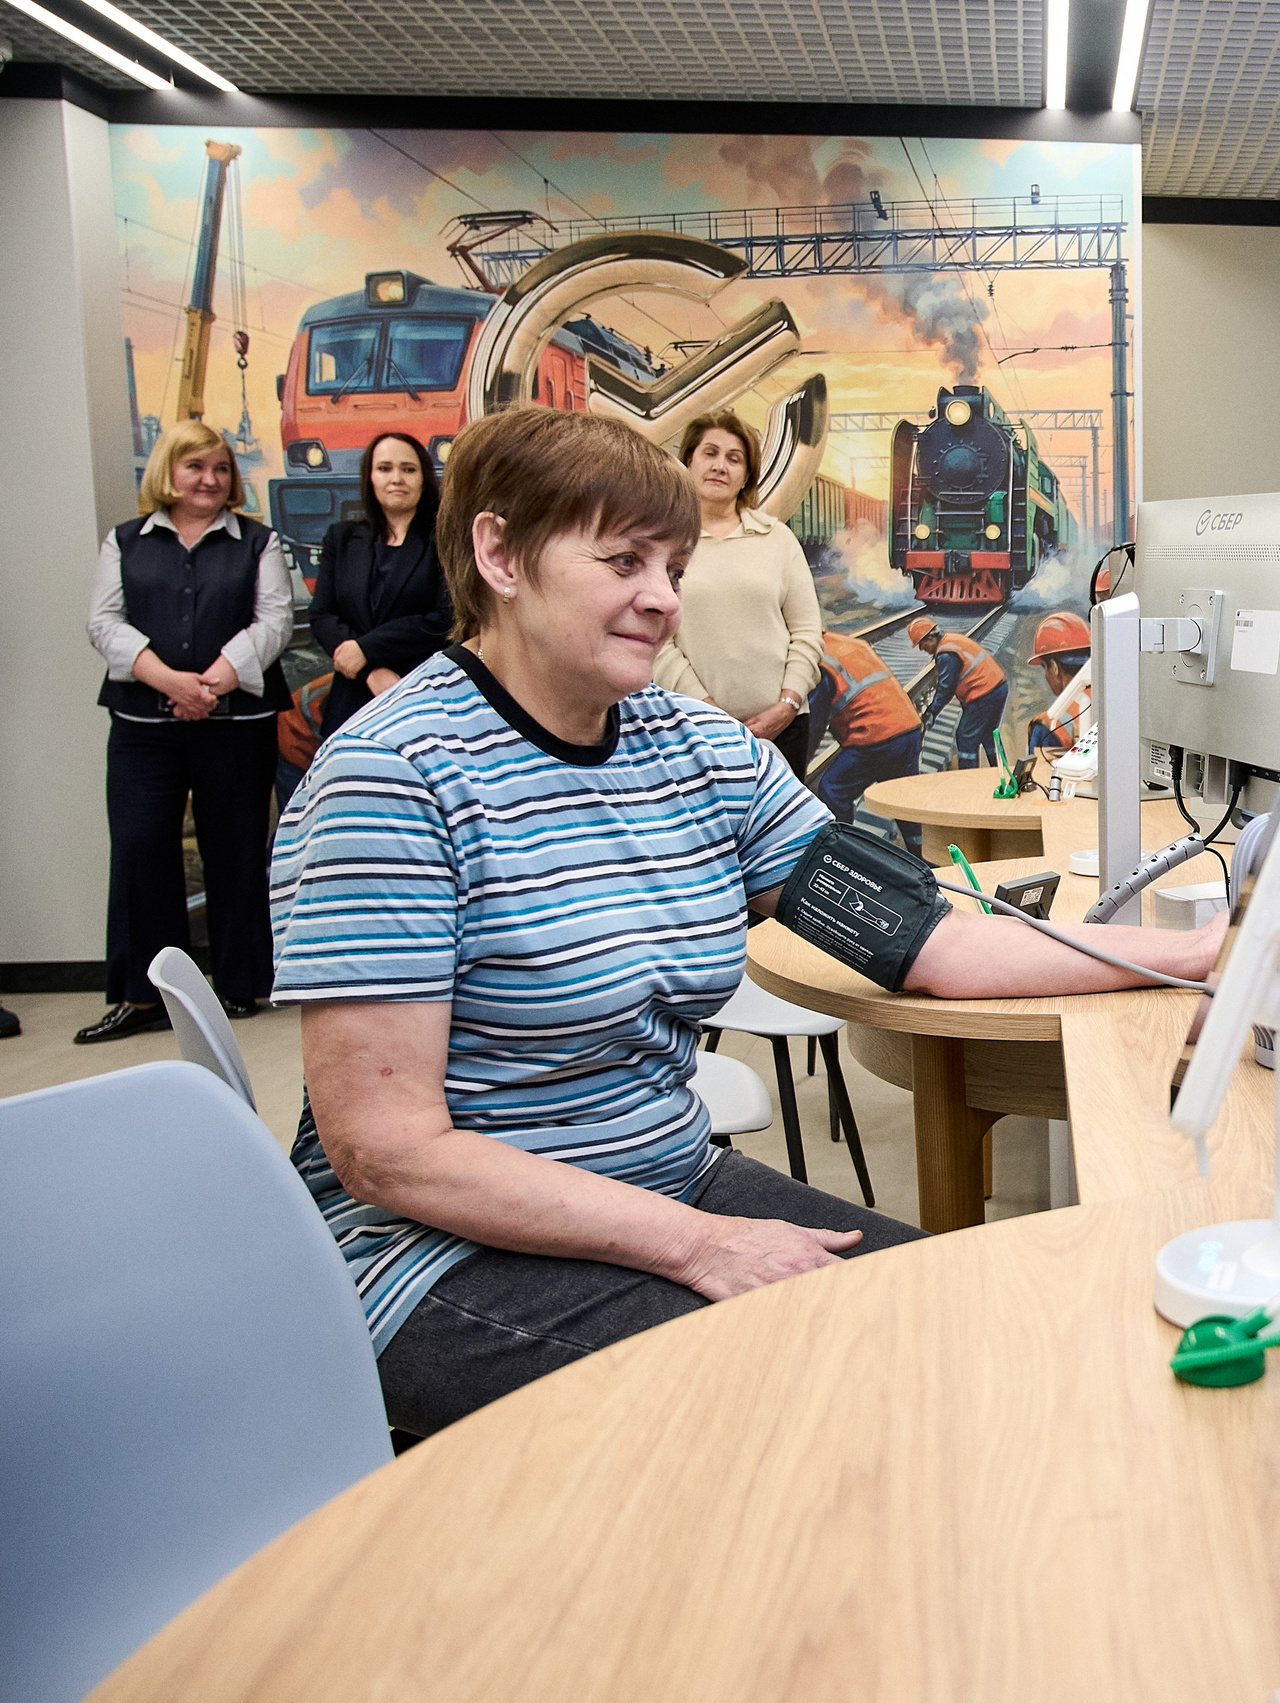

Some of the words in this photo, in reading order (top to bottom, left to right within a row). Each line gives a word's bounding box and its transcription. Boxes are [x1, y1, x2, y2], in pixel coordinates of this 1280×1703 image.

[1211, 513, 1243, 530] СБЕР
[831, 859, 850, 872] СБЕР
[848, 869, 883, 893] ЗДОРОВЬЕ
[800, 897, 812, 908] Как
[810, 905, 837, 923] наложить
[836, 920, 860, 937] манжету
